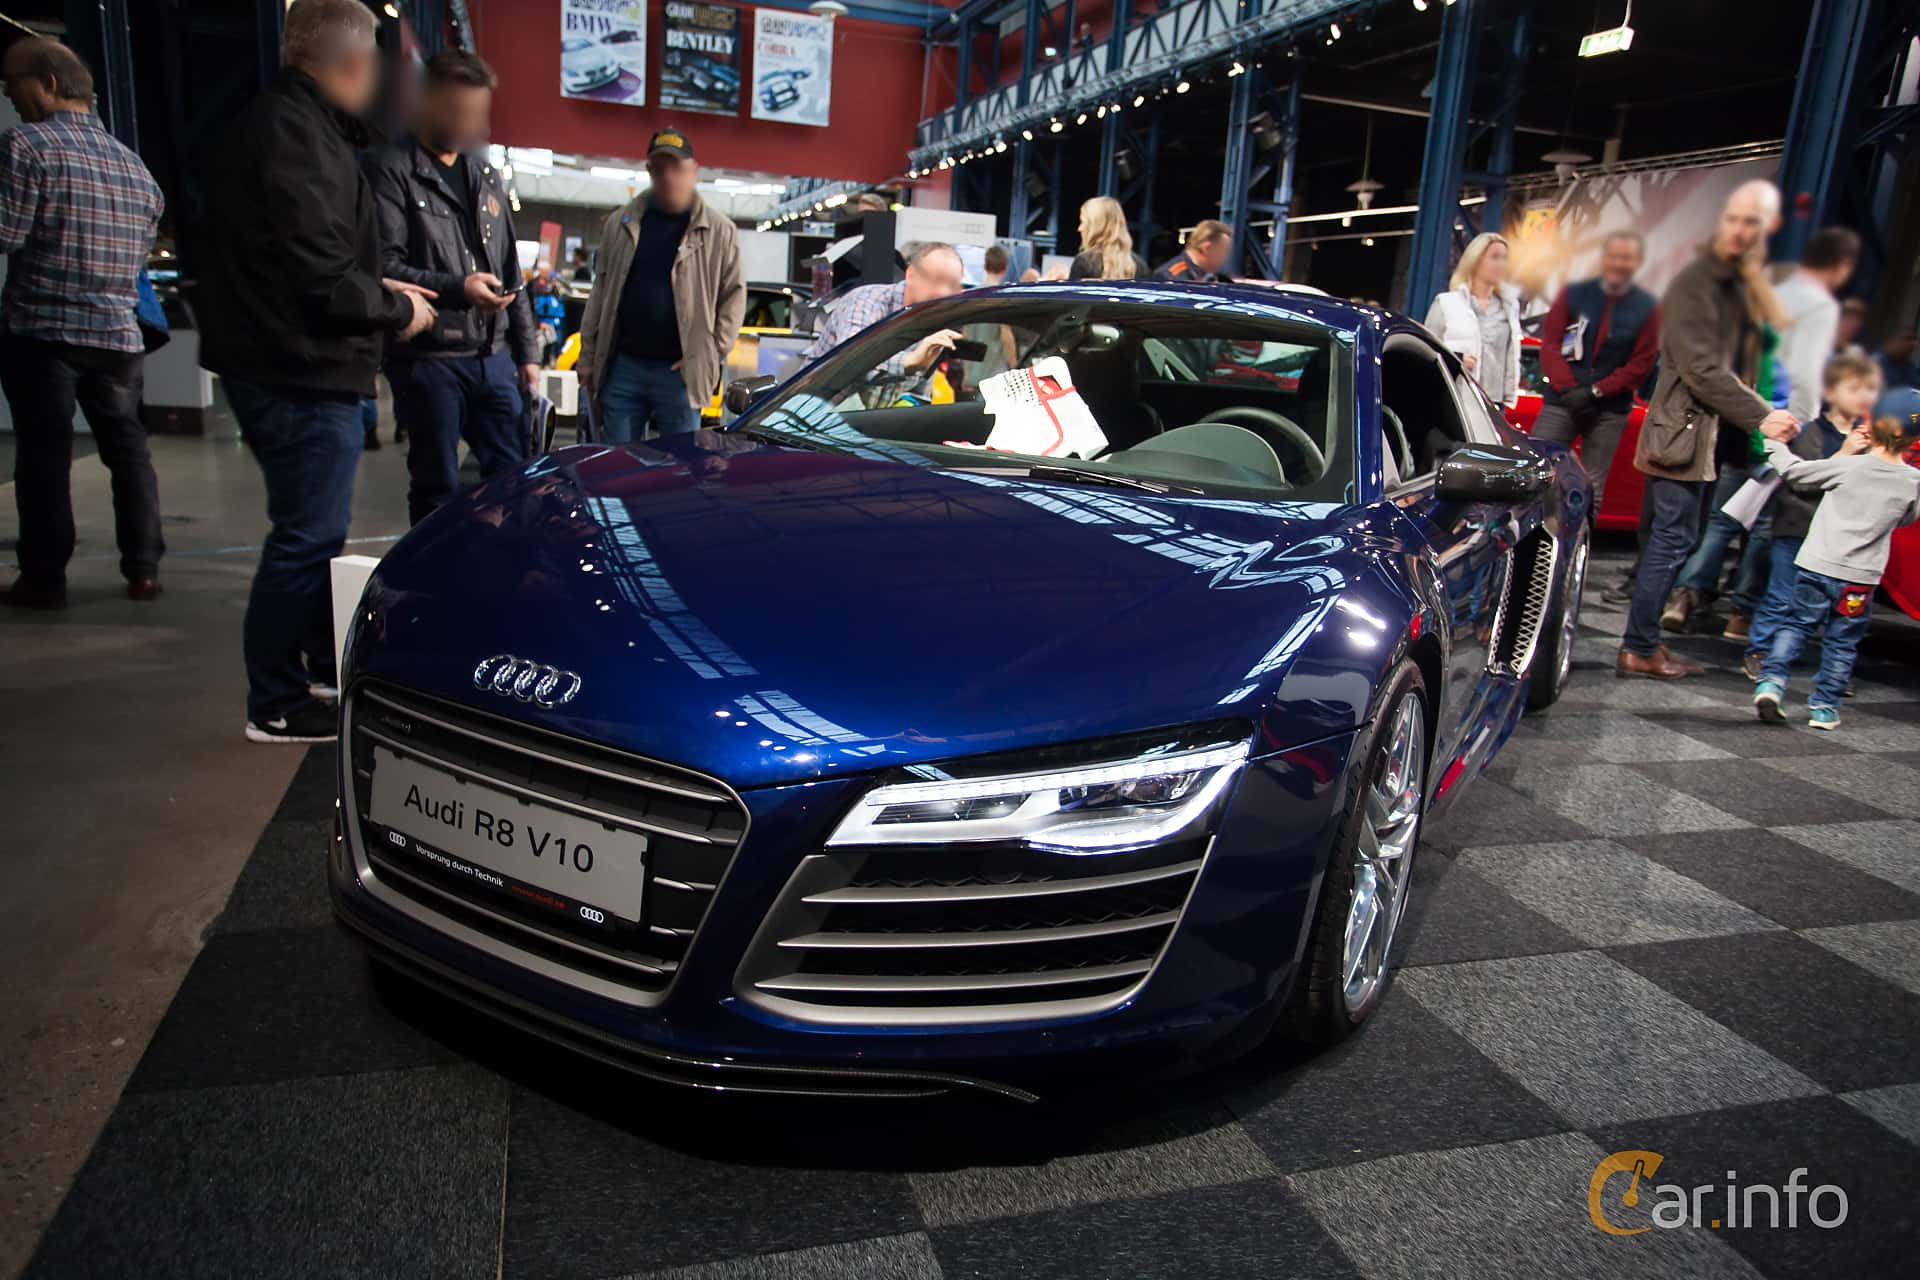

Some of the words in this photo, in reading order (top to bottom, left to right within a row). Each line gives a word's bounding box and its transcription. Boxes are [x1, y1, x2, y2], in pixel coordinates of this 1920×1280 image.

[566, 12, 613, 33] BMW
[665, 29, 737, 55] BENTLEY
[404, 783, 464, 830] Audi
[474, 808, 515, 848] R8
[526, 825, 594, 873] V10
[415, 843, 451, 868] Vorsprung
[452, 860, 473, 877] durch
[474, 868, 504, 888] Technik
